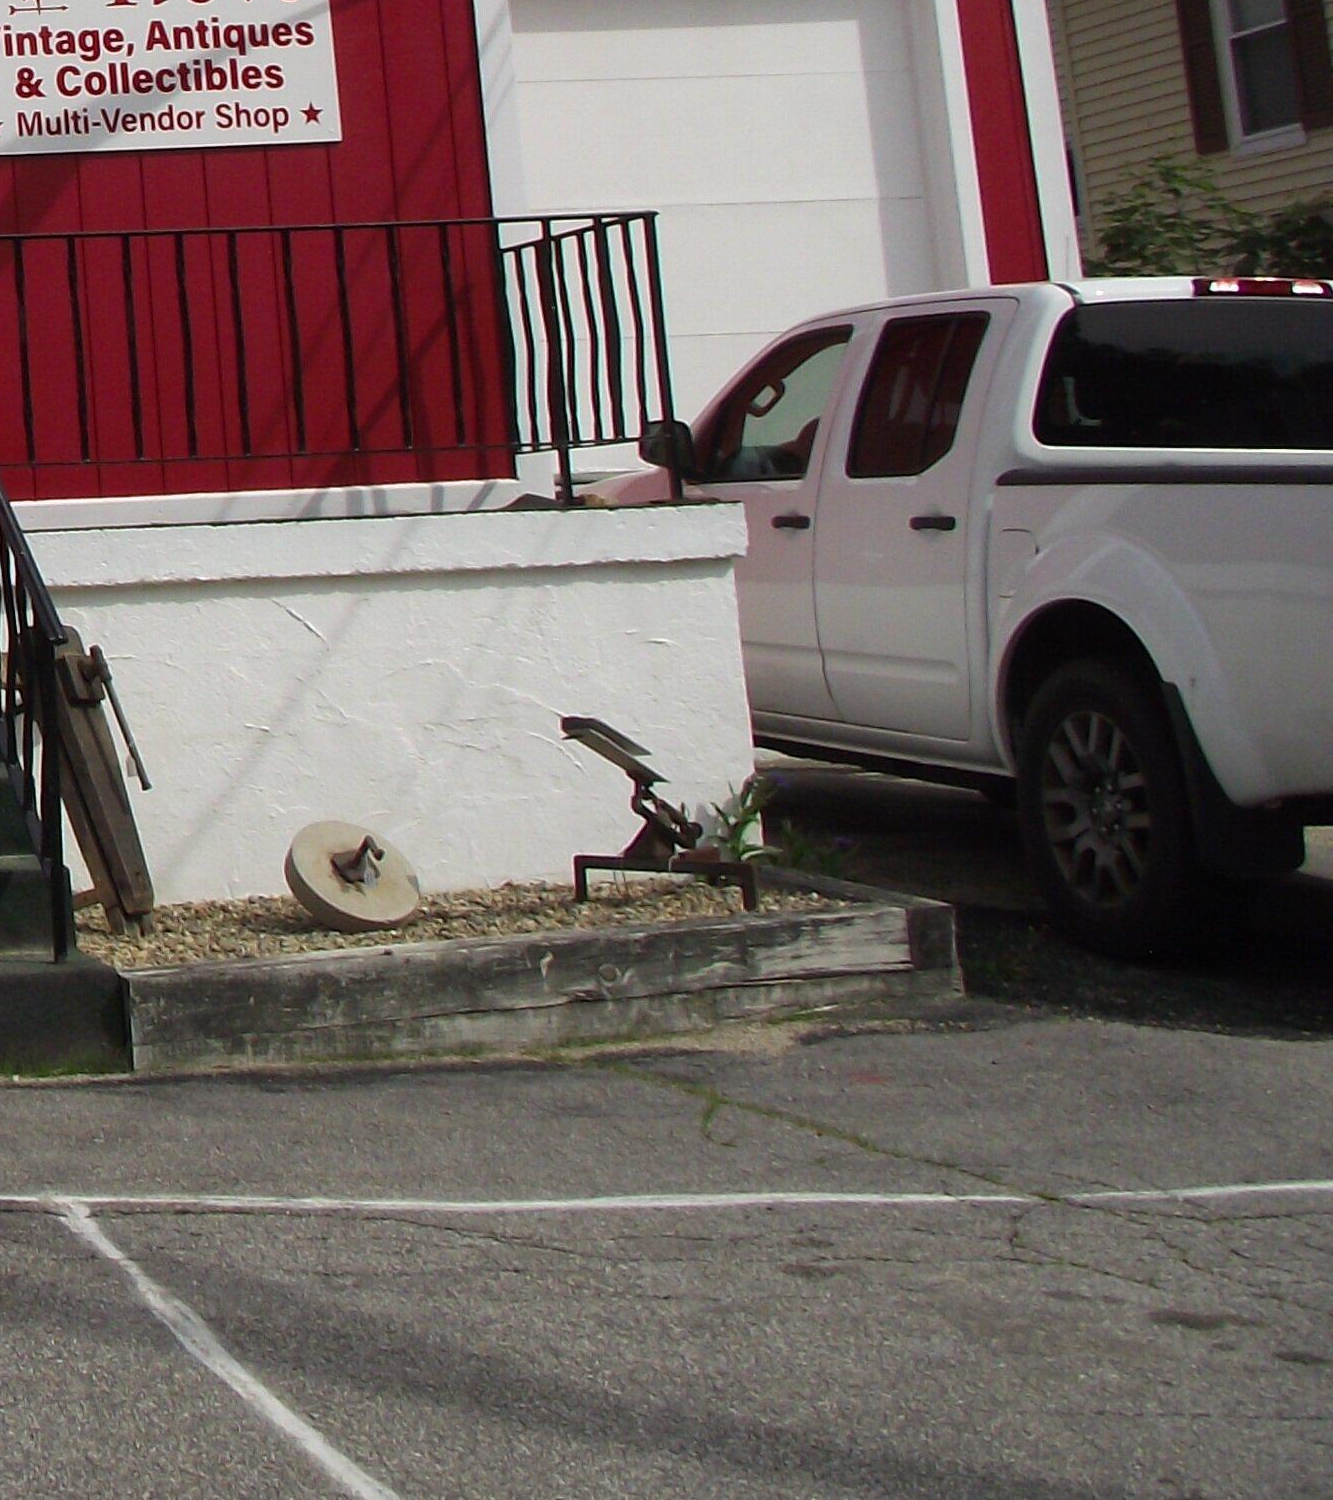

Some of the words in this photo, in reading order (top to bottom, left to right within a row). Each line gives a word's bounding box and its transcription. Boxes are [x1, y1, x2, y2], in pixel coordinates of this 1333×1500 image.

[146, 17, 315, 56] Antiques
[15, 67, 46, 99] &
[56, 59, 285, 97] Collectibles
[17, 104, 206, 137] Multi-Vendor
[216, 102, 290, 133] Shop
